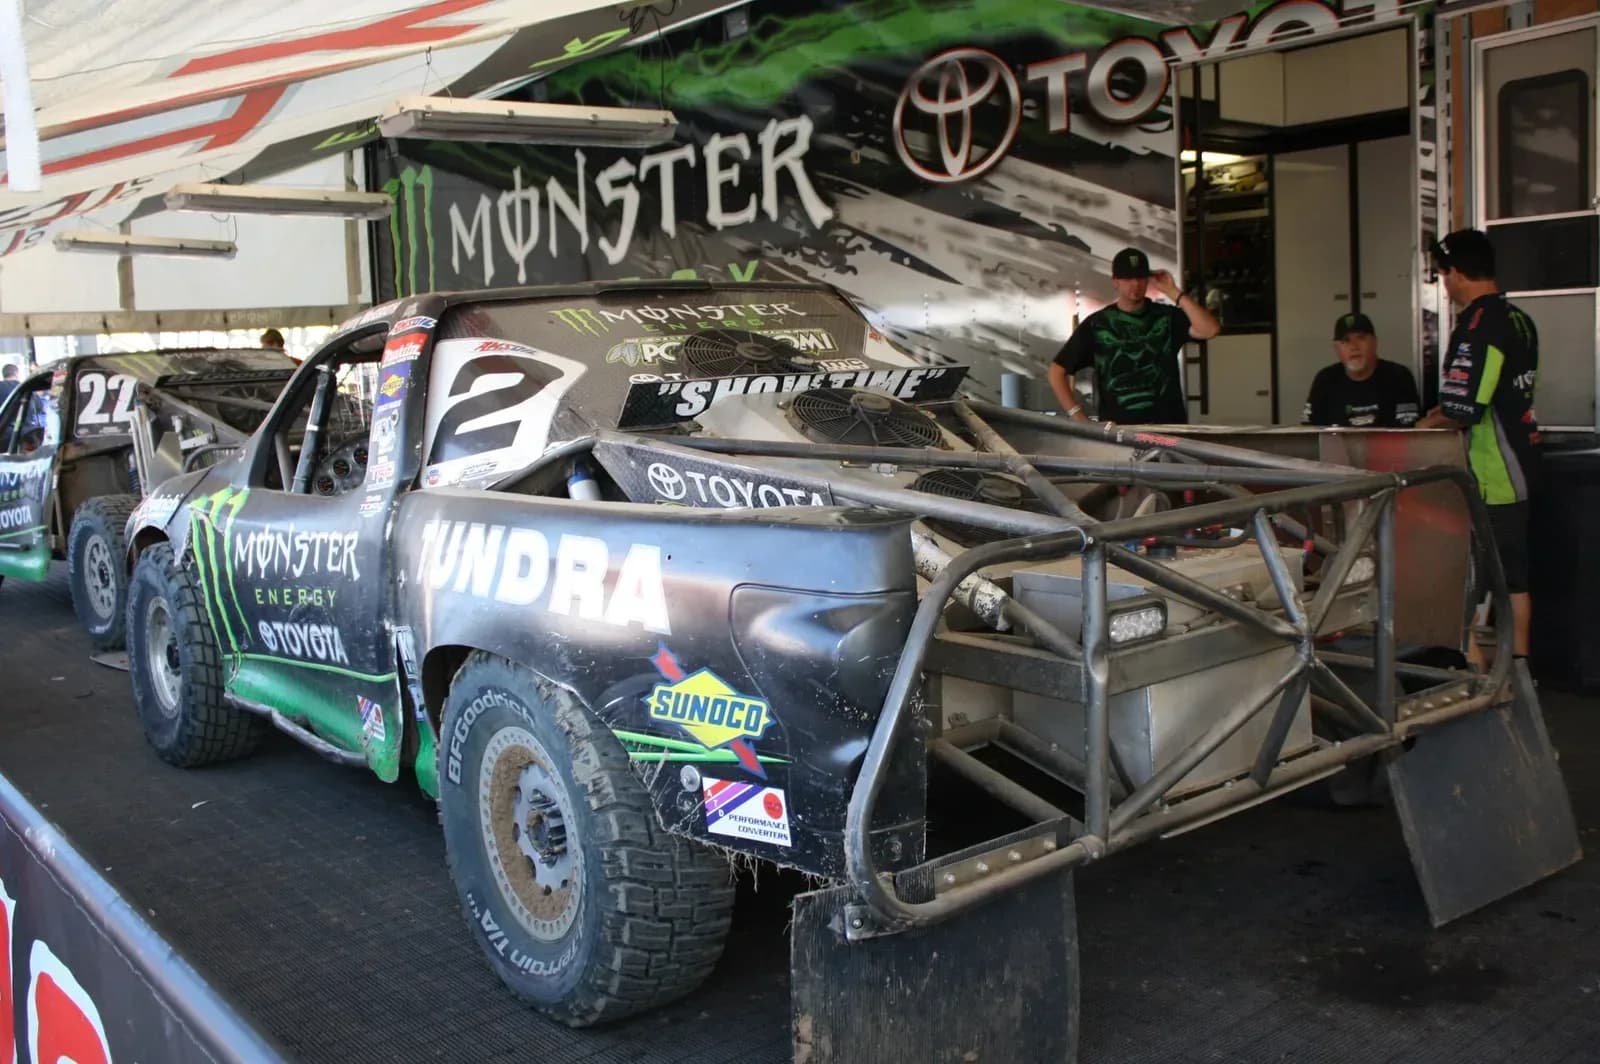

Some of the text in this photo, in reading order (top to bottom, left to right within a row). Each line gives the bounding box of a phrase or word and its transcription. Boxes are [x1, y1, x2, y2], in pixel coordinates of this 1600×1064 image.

[77, 372, 139, 425] 22
[428, 355, 565, 466] 2
[0, 504, 33, 530] OYOTA
[233, 522, 361, 582] MONSTER
[255, 588, 337, 608] ENERGY
[415, 519, 673, 637] TUNDRA
[275, 620, 350, 665] TOYOTA
[654, 690, 764, 733] SUNOCO
[729, 815, 788, 830] PERFORMANCE
[738, 825, 789, 841] CONVERTERS
